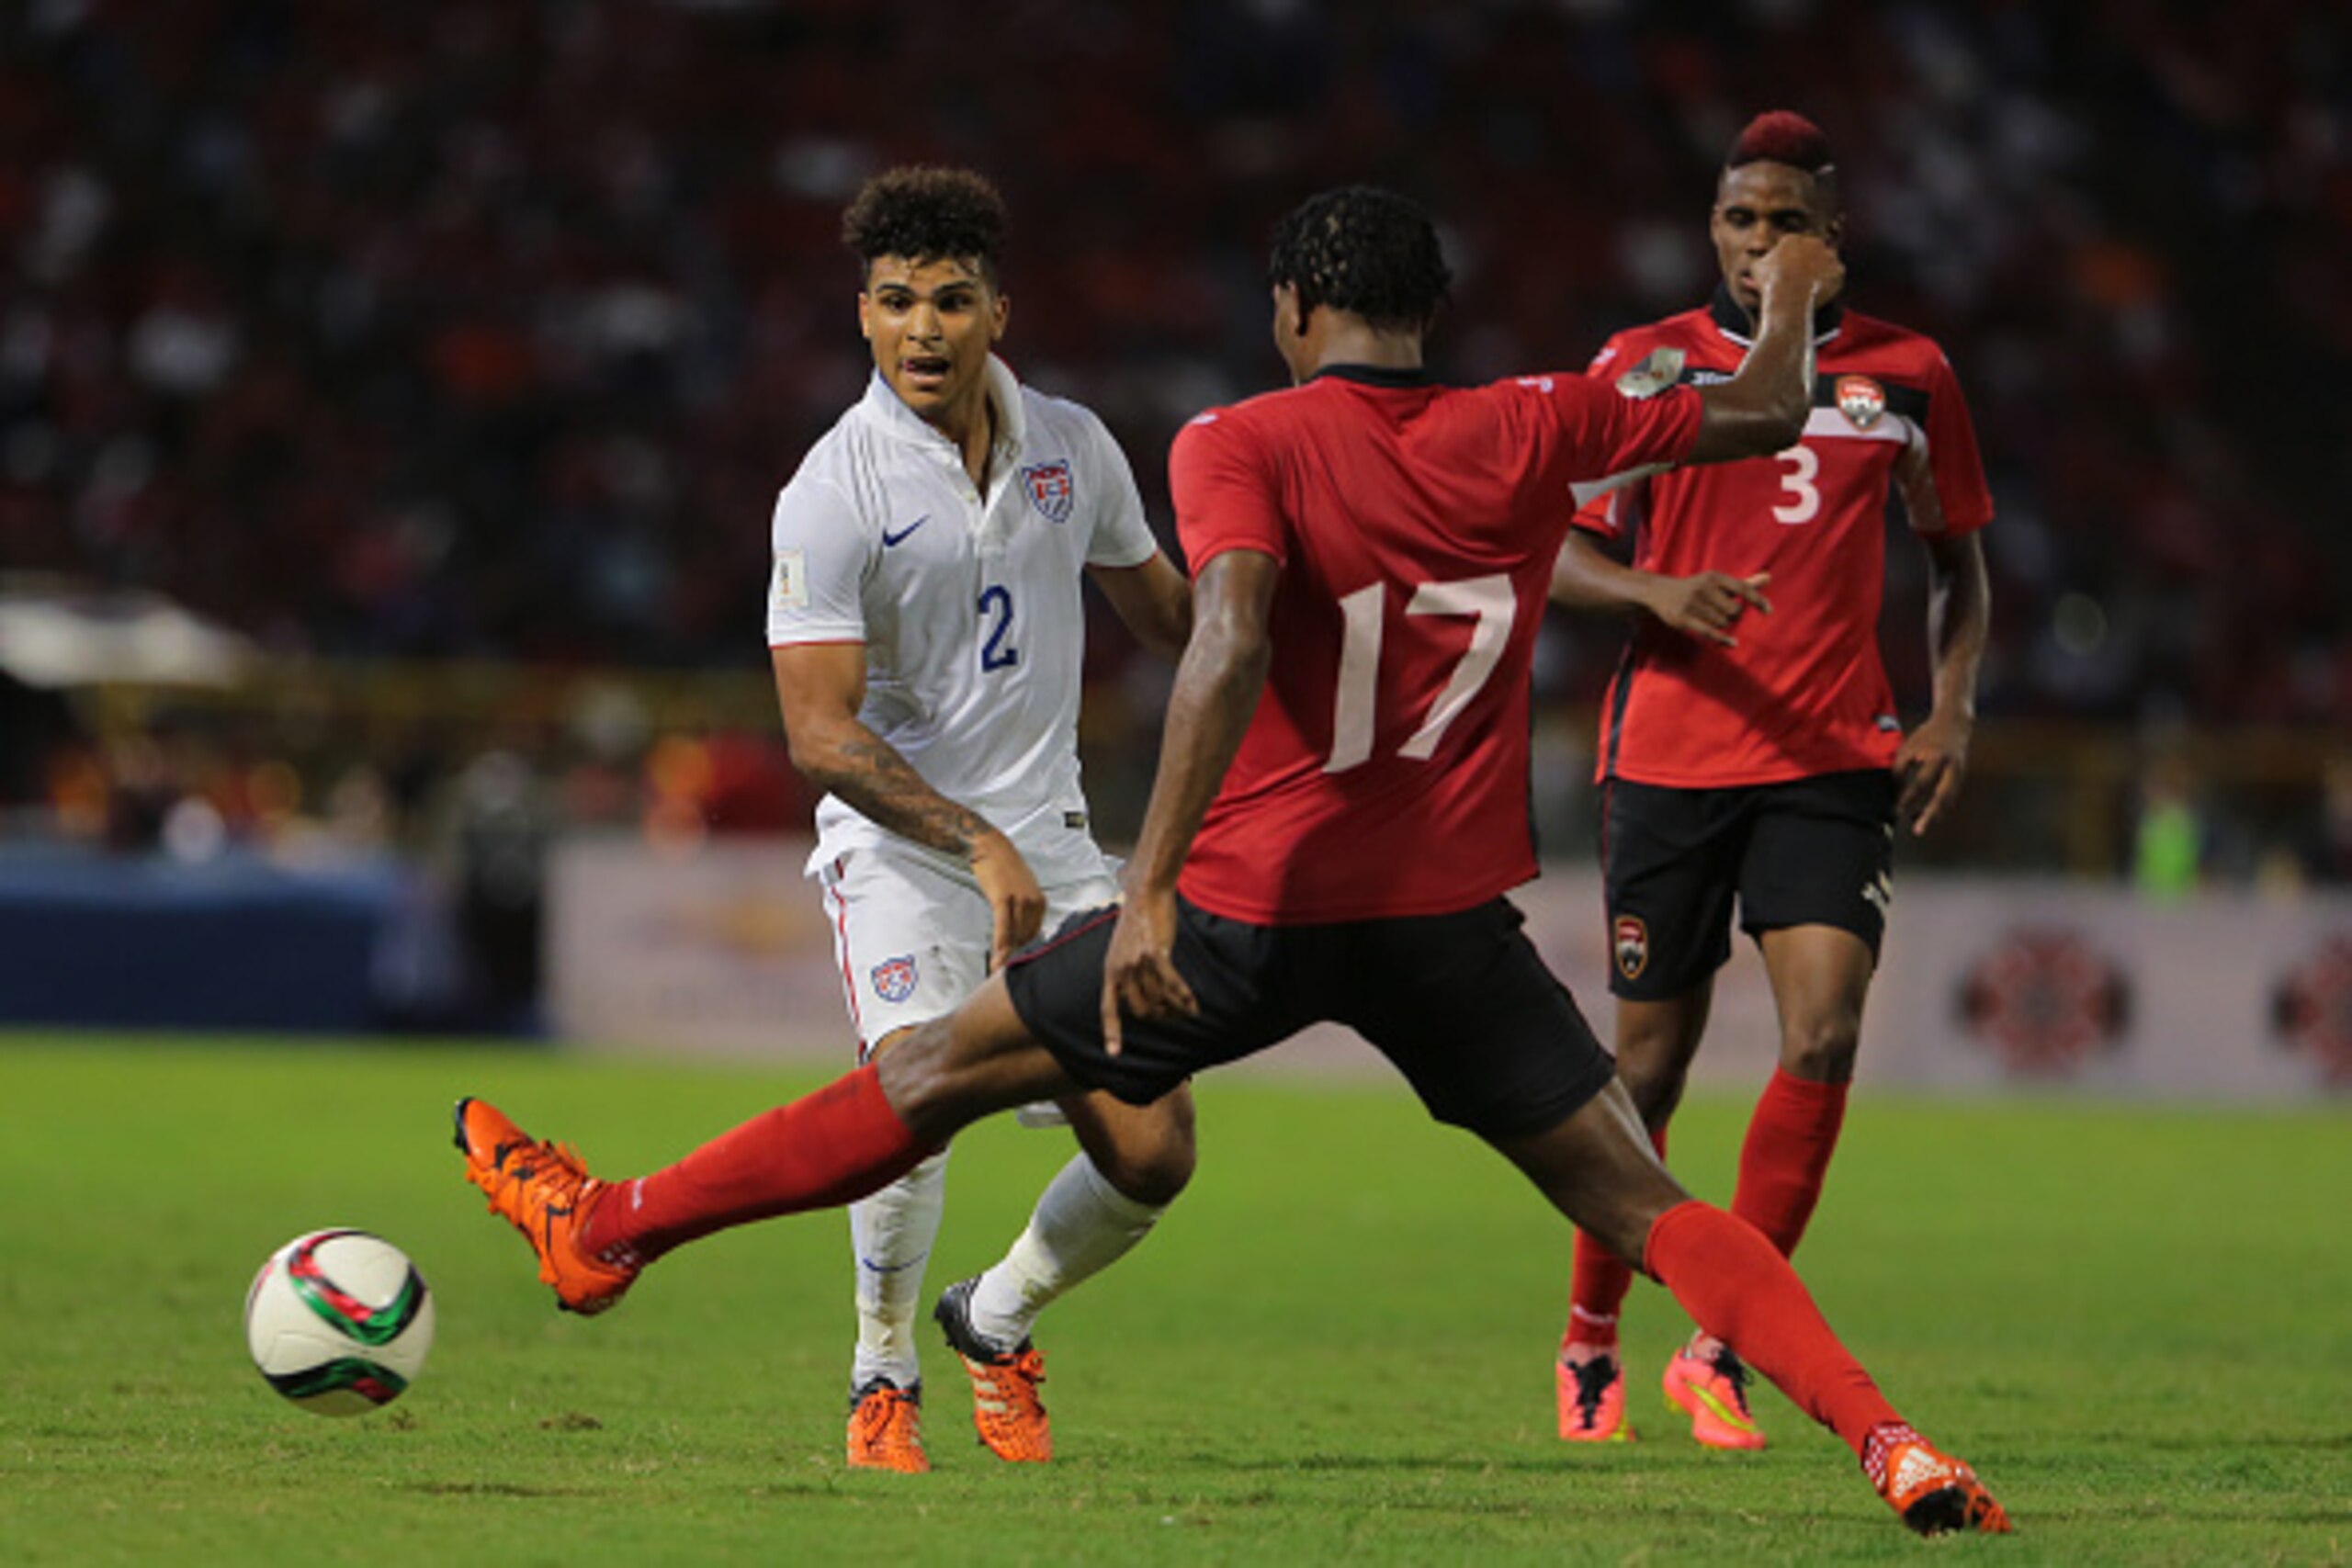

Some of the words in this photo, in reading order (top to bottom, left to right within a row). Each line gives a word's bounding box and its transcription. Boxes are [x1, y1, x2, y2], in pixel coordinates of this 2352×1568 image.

[1771, 444, 1820, 525] 3
[978, 585, 1018, 673] 2
[1322, 573, 1517, 773] 17
